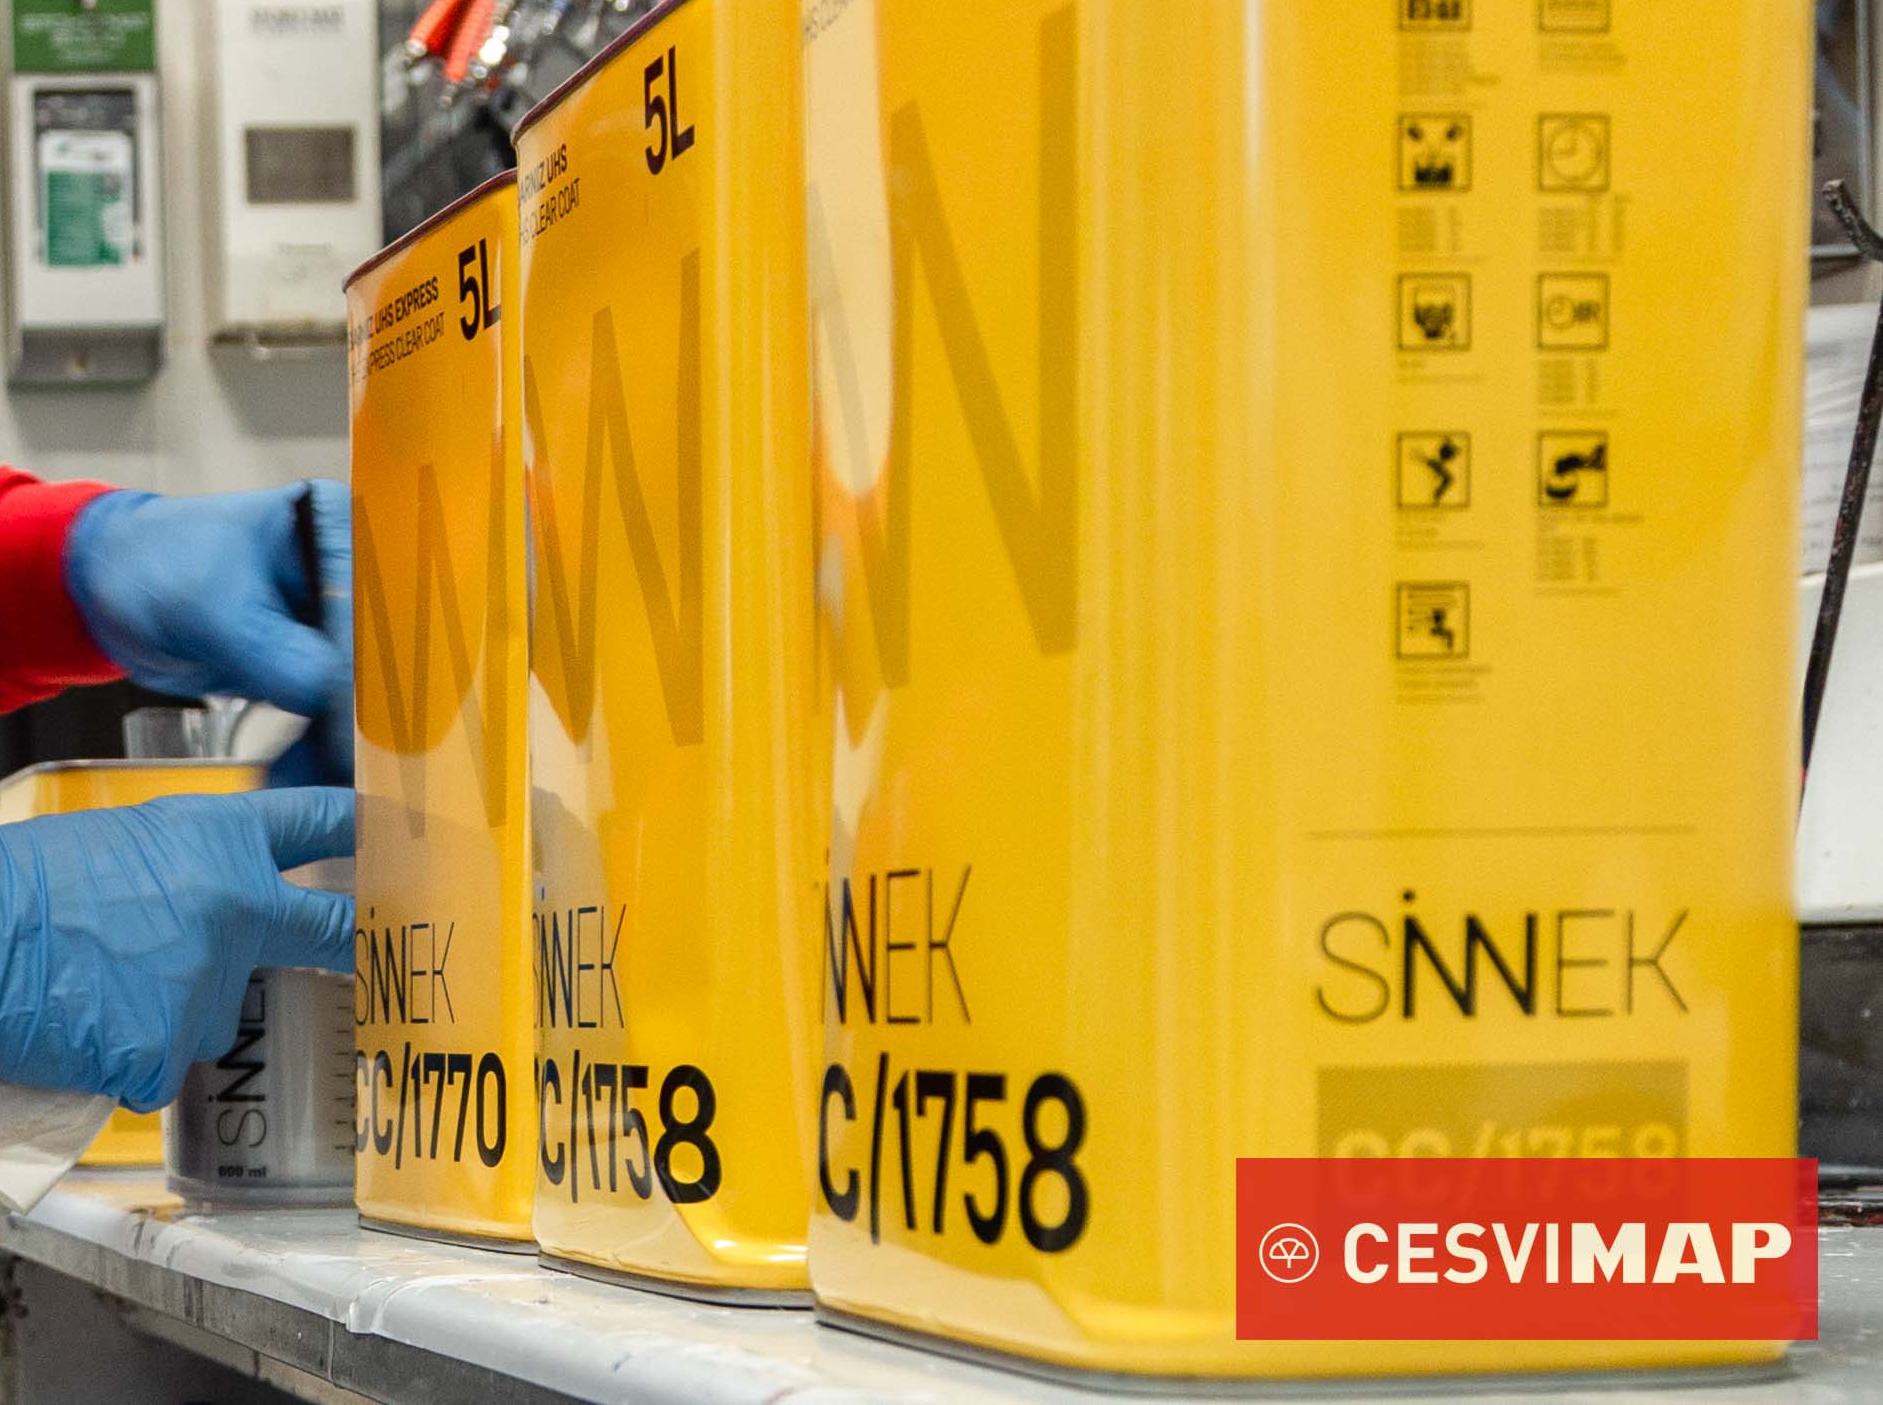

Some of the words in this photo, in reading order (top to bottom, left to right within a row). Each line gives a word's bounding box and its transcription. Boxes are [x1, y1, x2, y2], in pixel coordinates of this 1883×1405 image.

[644, 45, 695, 176] 5L
[520, 161, 545, 206] ARNIZ
[546, 143, 567, 184] UHS
[557, 177, 580, 219] COAT
[375, 301, 394, 333] UHS
[395, 276, 439, 322] EXPRESS
[457, 237, 501, 341] 5L
[396, 325, 422, 361] CLEAR
[421, 311, 445, 344] COAT
[353, 1041, 507, 1171] CC/1770
[534, 1049, 722, 1204] C/1758
